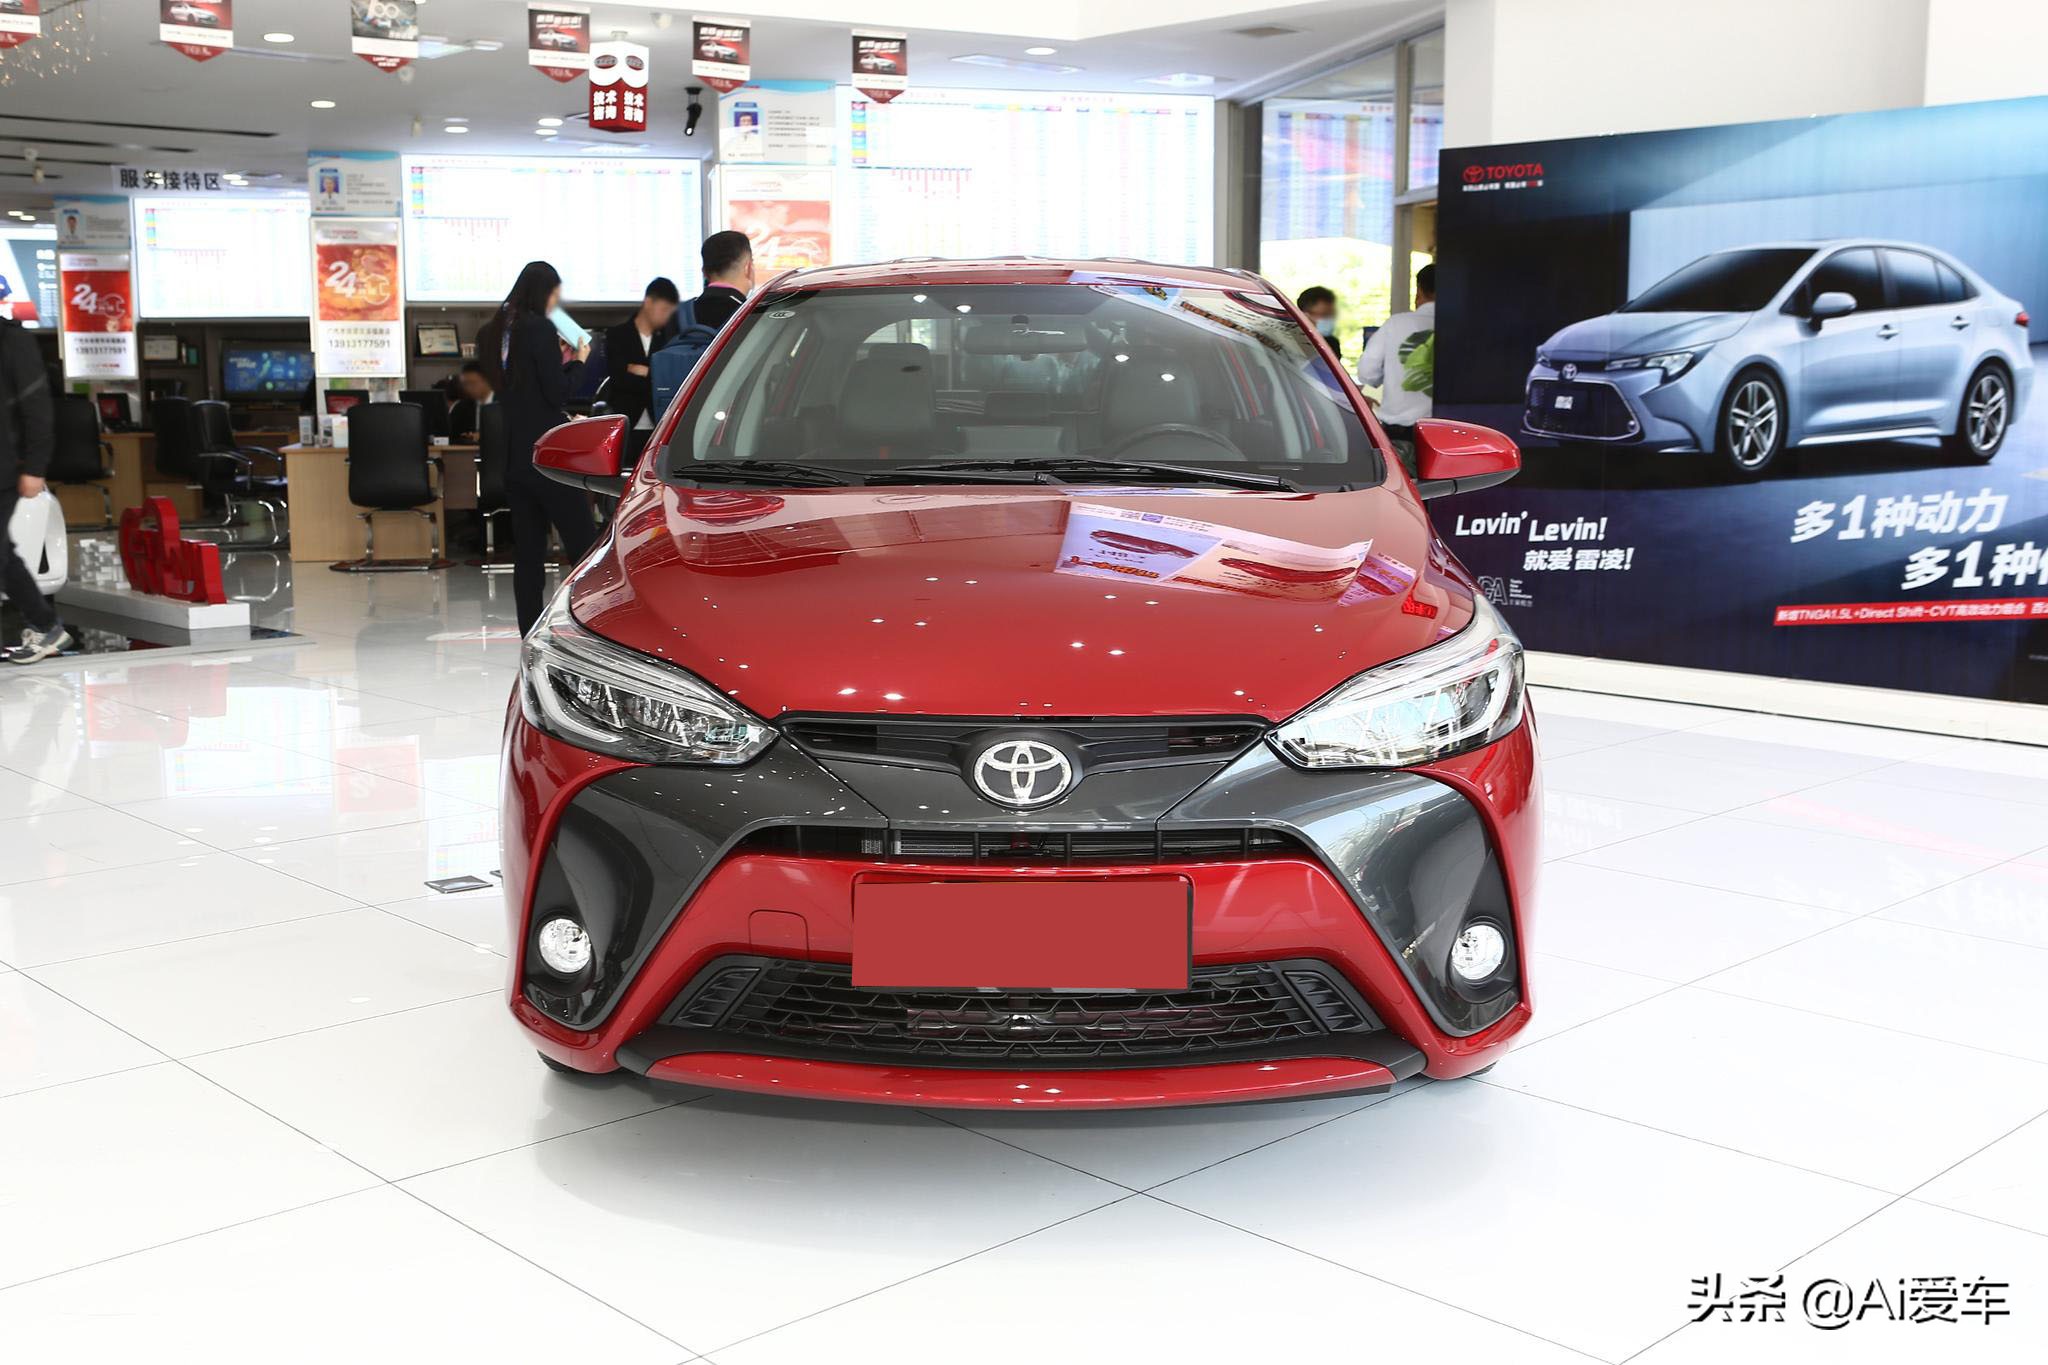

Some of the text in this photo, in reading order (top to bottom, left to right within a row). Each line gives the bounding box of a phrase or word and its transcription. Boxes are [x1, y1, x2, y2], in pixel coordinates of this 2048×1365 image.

[120, 168, 221, 190] 服务接待区
[1487, 163, 1543, 179] TOYOTA
[324, 260, 357, 298] 24
[71, 283, 98, 315] 24
[1528, 517, 1608, 542] Levin!
[1790, 487, 2009, 543] 多1种动力
[1901, 541, 2048, 590] 多1种
